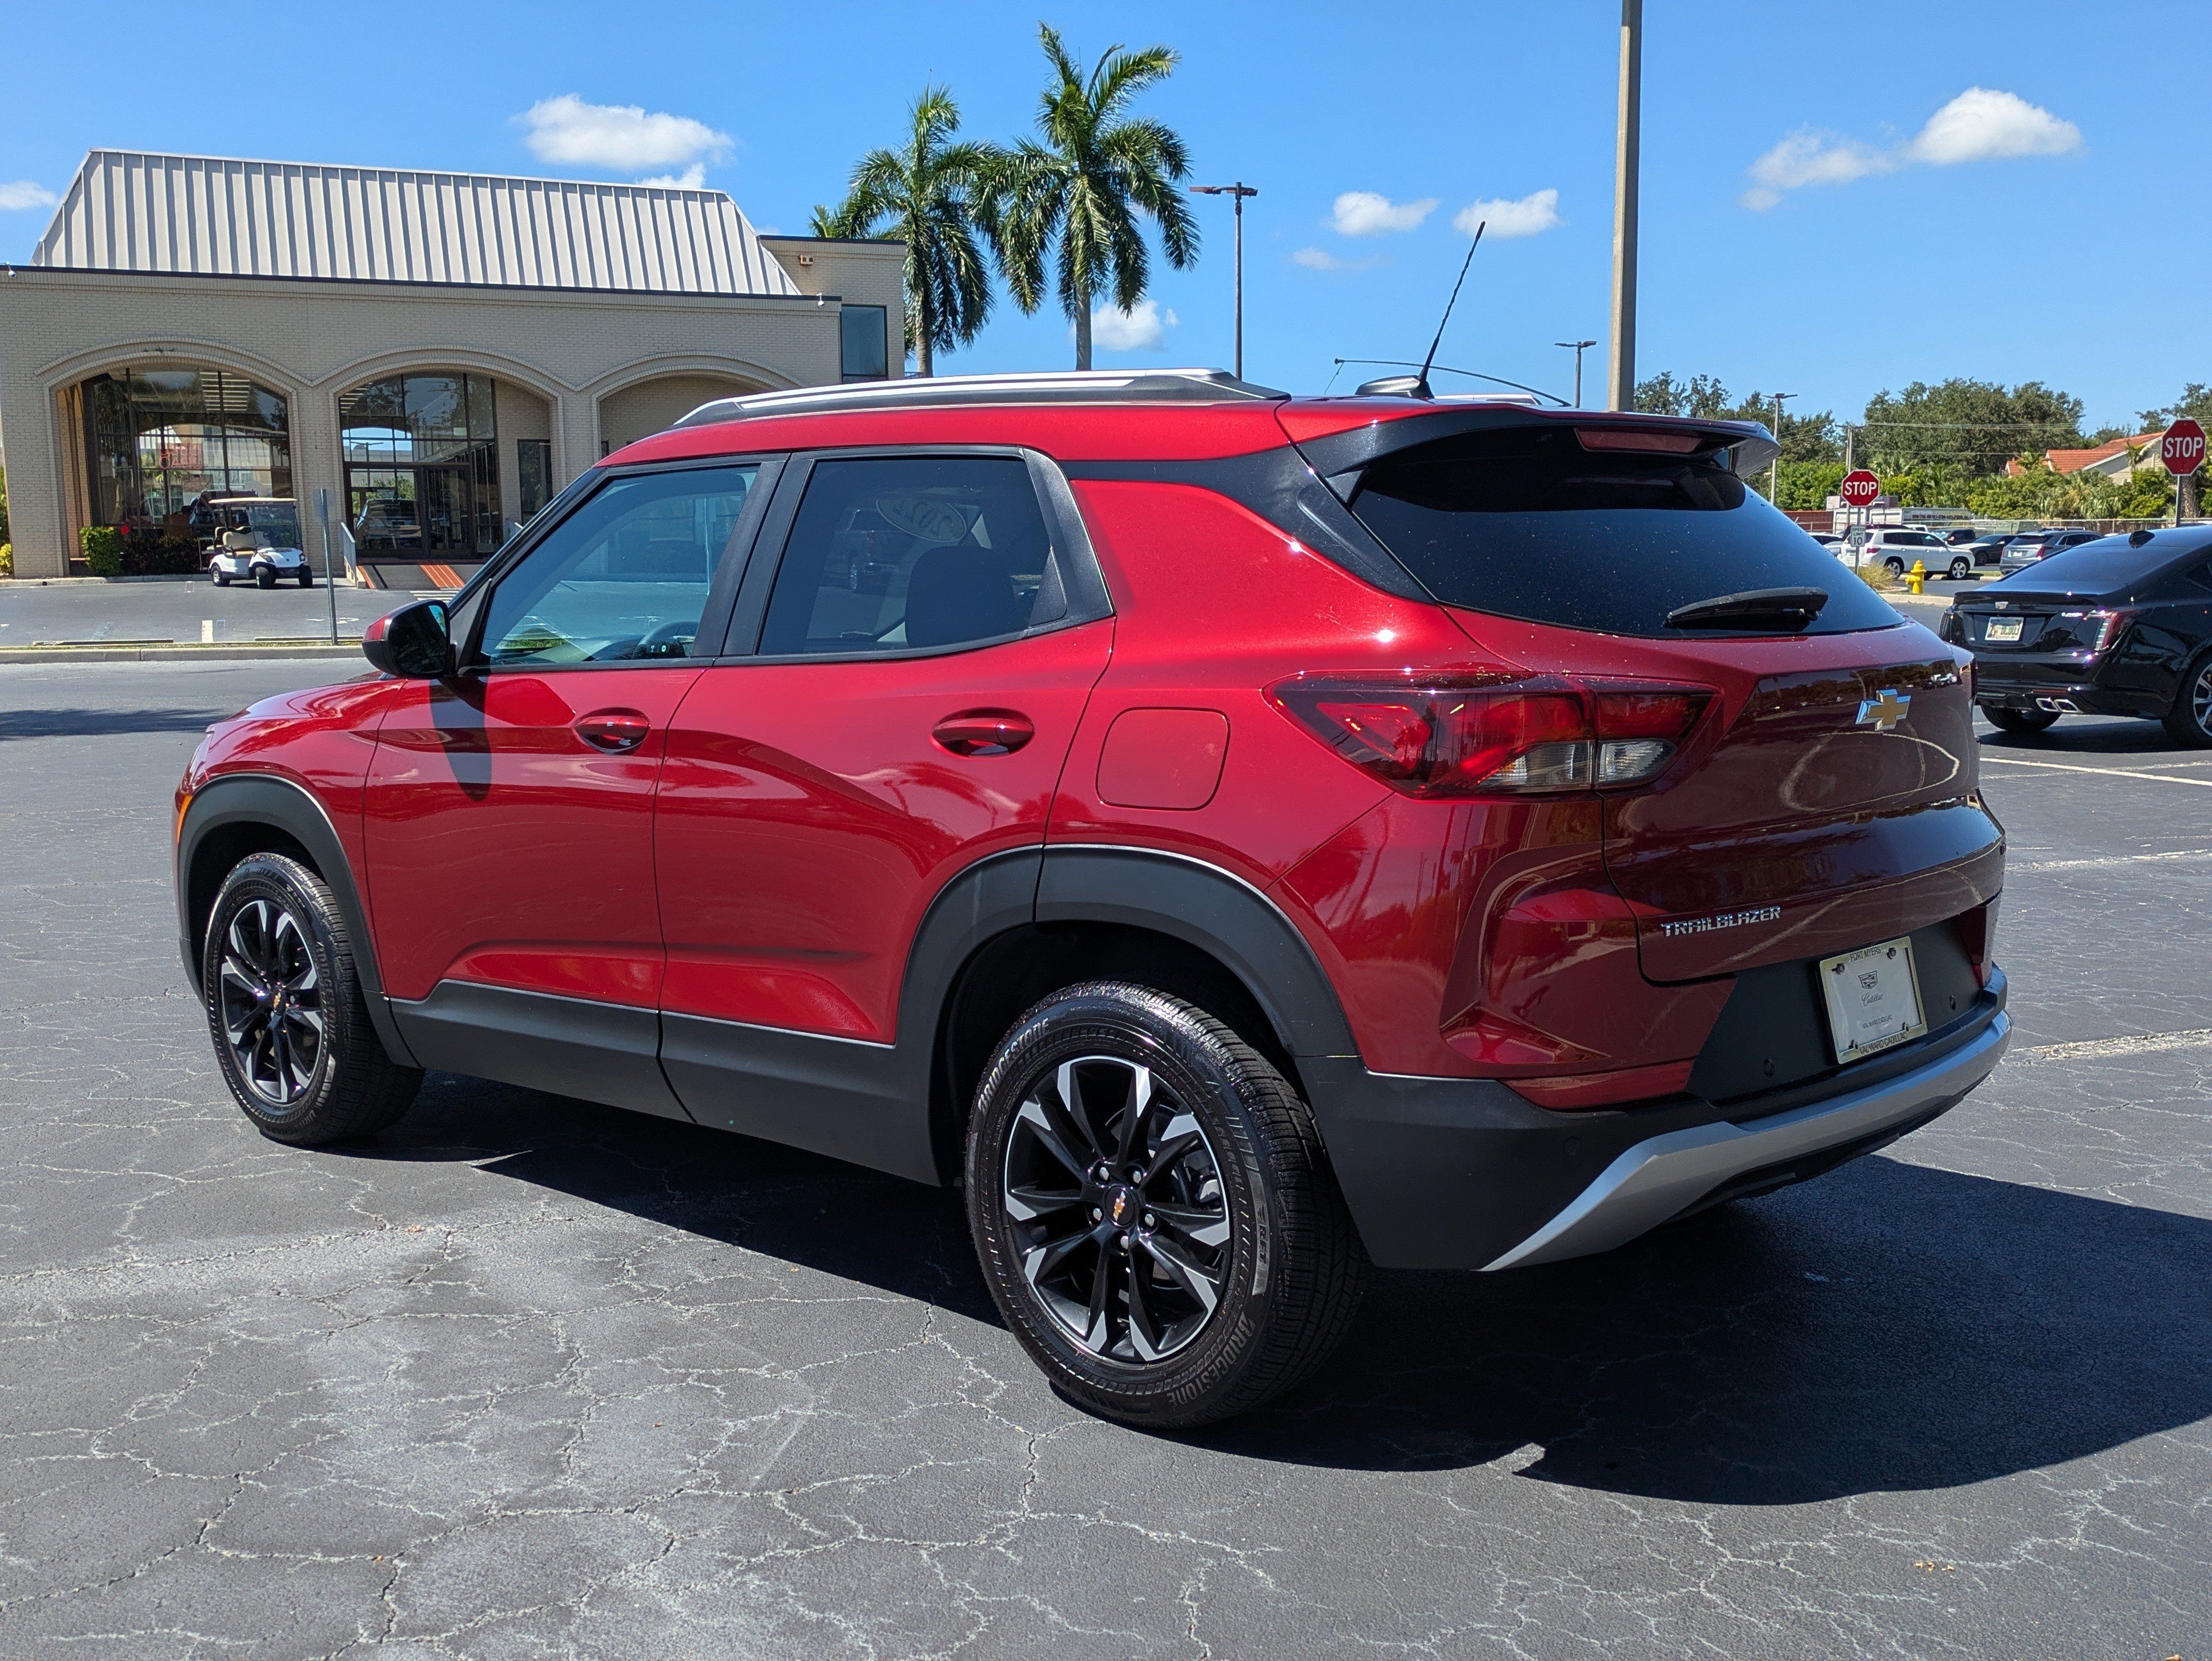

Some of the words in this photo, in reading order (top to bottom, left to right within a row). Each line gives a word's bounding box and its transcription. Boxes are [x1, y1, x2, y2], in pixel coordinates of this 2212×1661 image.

[2164, 437, 2203, 458] STOP
[1844, 481, 1877, 496] STOP
[1853, 537, 1863, 545] 10
[1660, 906, 1781, 937] TRAILBLAZER
[1850, 950, 1863, 962] FORT
[1864, 946, 1881, 957] MYERS
[1859, 1045, 1869, 1055] VAL
[1869, 1040, 1884, 1051] WARD
[1884, 1031, 1908, 1046] CADILLAC
[978, 1018, 1049, 1116] BRIDGESTONE
[1259, 1224, 1267, 1265] RFT
[1166, 1311, 1256, 1407] BRIDGESTONE
